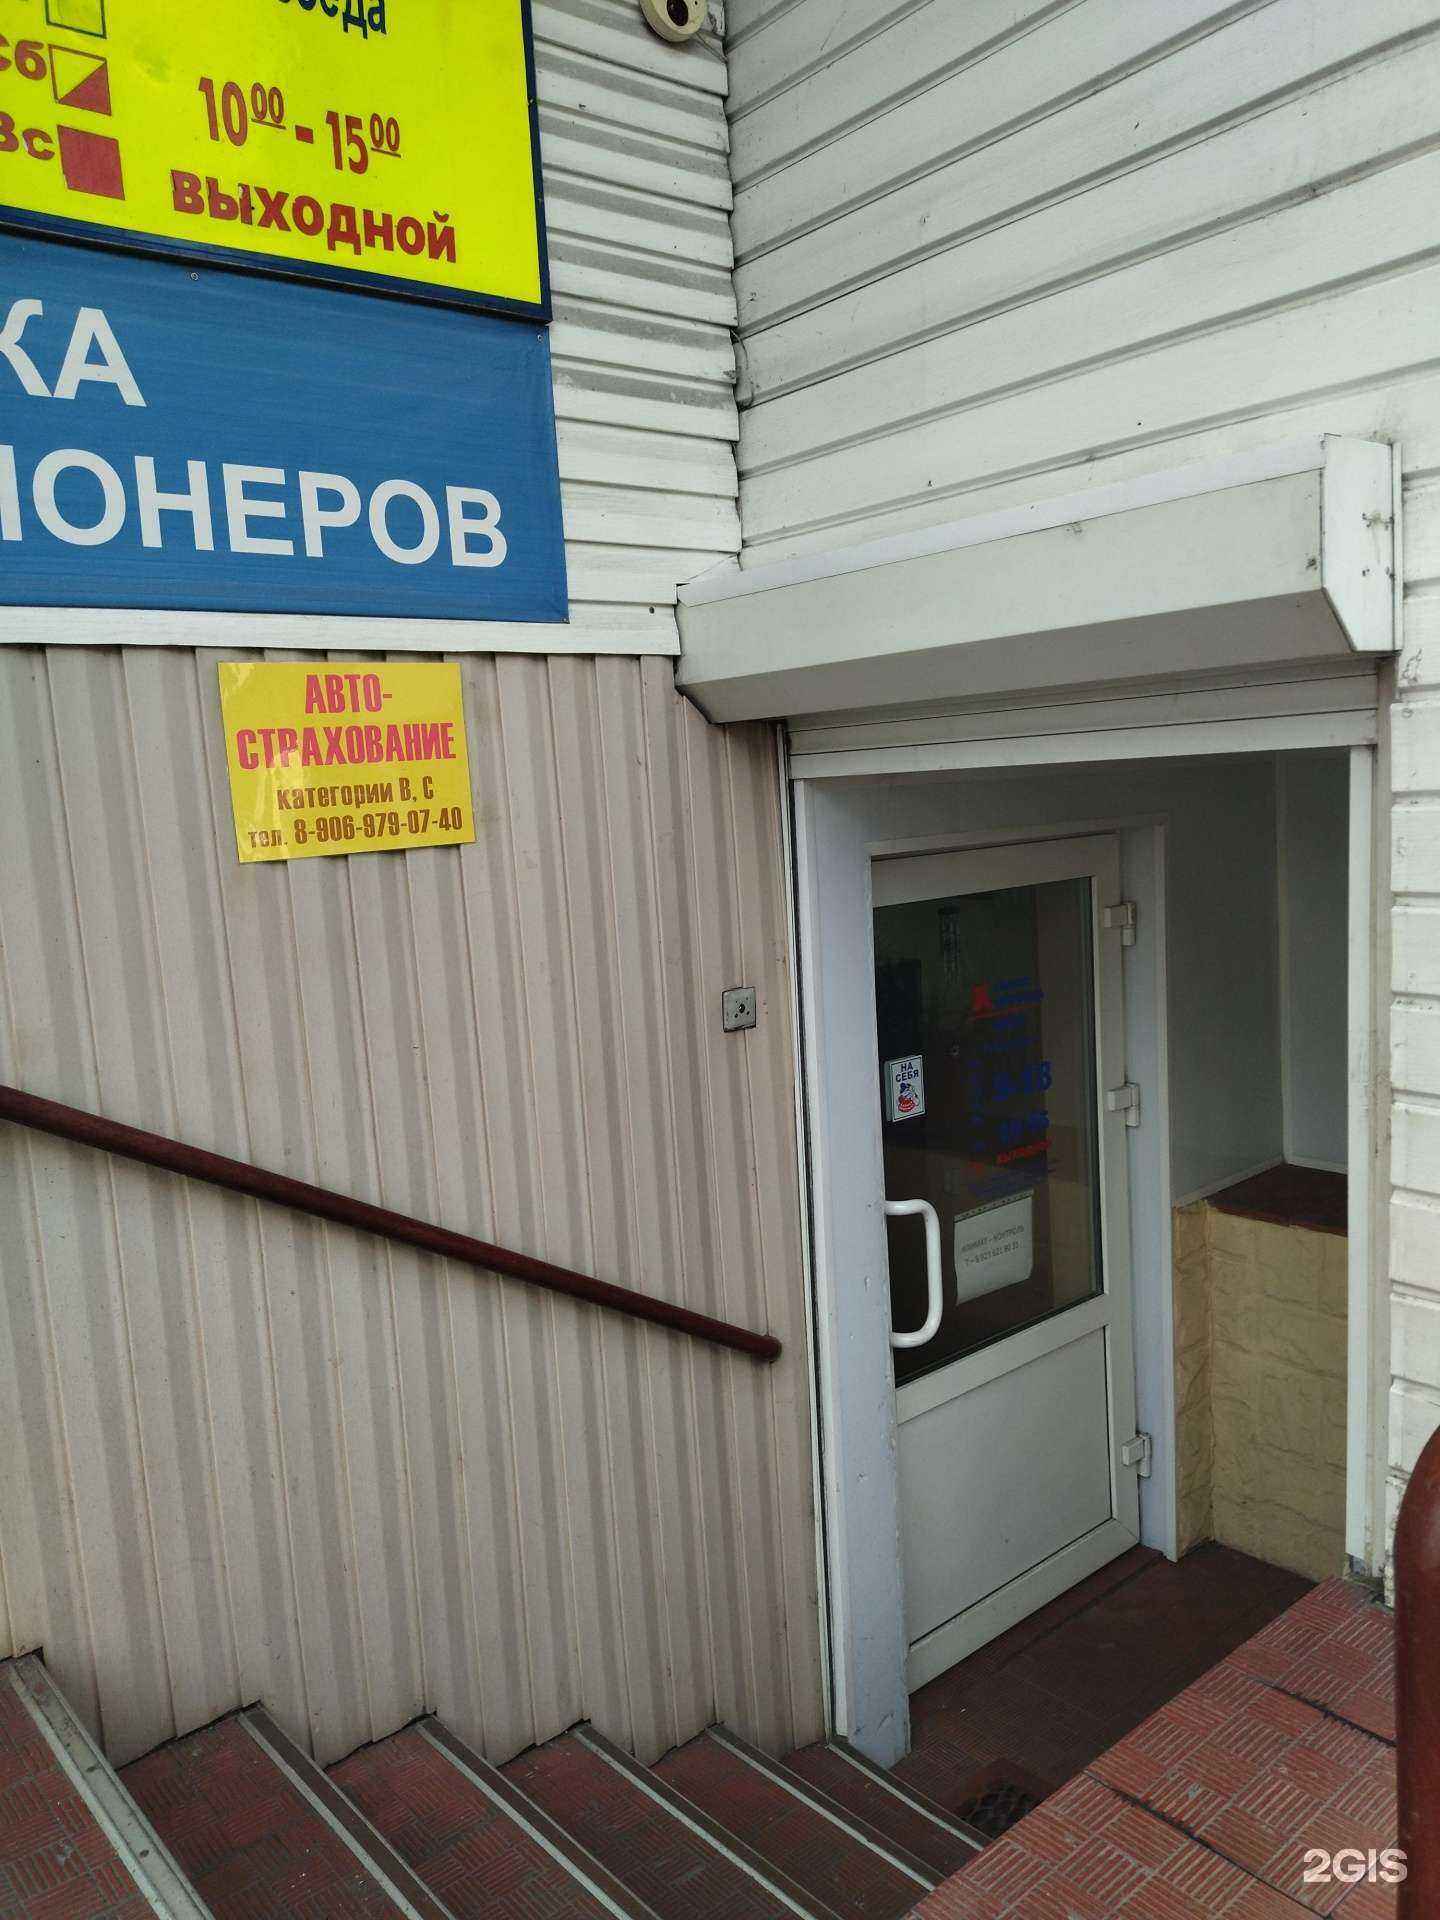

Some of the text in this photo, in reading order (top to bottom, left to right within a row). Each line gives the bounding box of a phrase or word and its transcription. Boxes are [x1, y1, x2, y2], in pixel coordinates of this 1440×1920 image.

[0, 445, 508, 568] ОНЕРОВ
[305, 673, 393, 714] АВТО-
[236, 722, 457, 770] СТРАХОВАНИЕ
[277, 782, 393, 810] категории
[248, 806, 463, 848] тел. 8-906-979-07-40
[895, 1069, 919, 1082] СЕБЯ
[900, 1062, 914, 1073] НА
